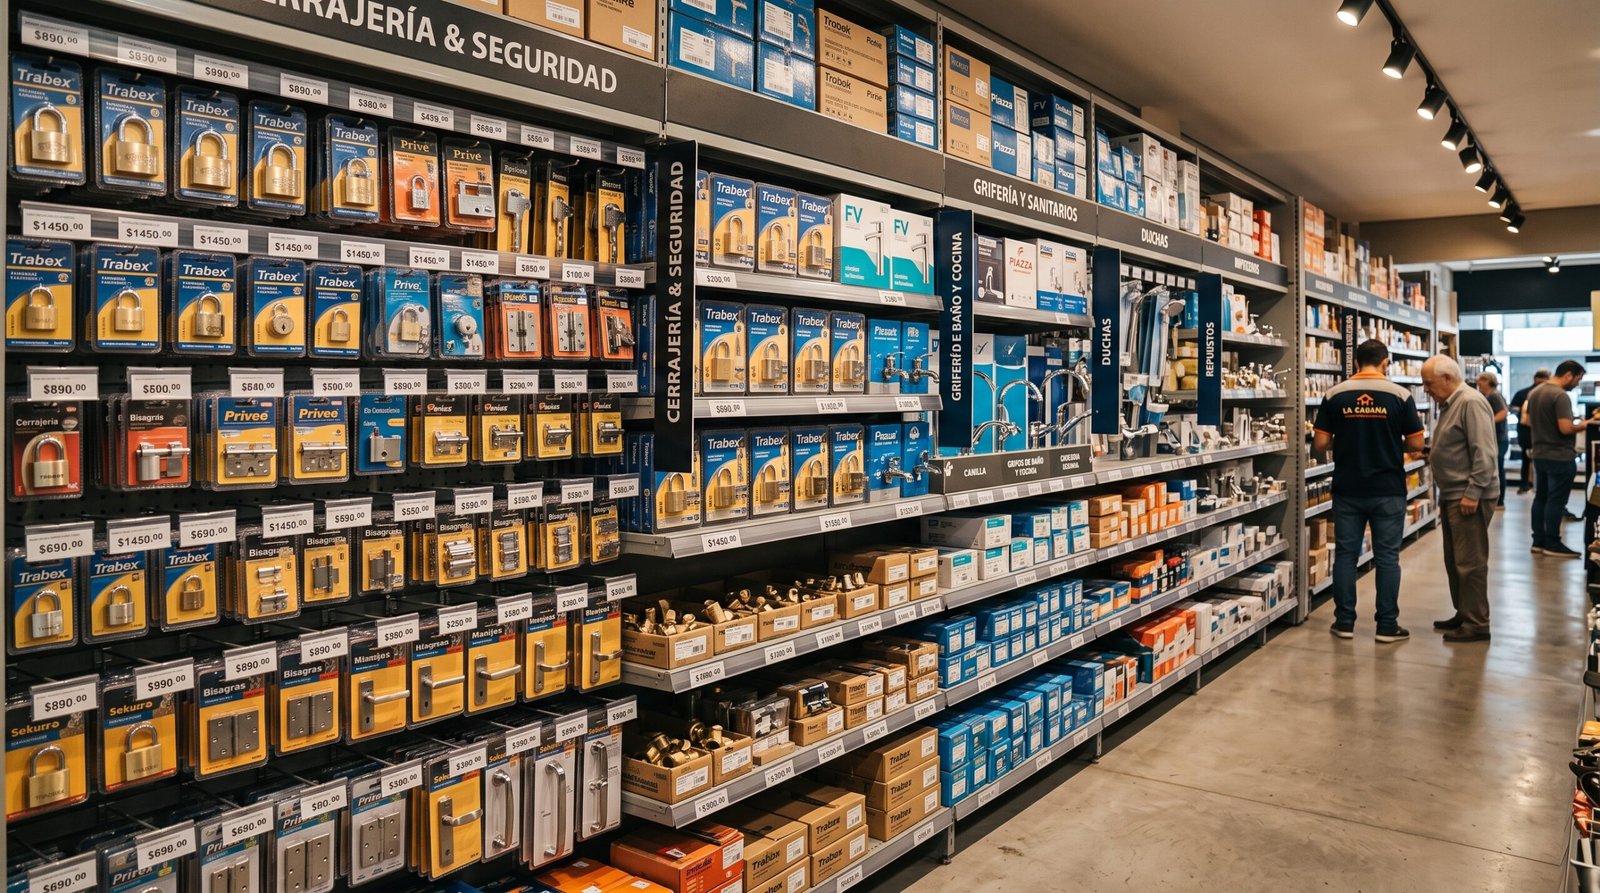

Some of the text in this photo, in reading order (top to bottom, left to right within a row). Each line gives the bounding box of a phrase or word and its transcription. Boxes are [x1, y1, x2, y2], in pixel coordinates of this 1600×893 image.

[34, 30, 78, 46] $890.00
[444, 25, 464, 54] &
[472, 32, 617, 94] SEGURIDAD
[17, 68, 72, 88] Trabex
[205, 67, 240, 80] $990.00
[107, 83, 155, 102] Trabex
[289, 84, 321, 96] $890.00
[185, 100, 229, 116] Trabex
[991, 93, 1013, 110] Piazza
[1034, 101, 1046, 110] FV
[258, 114, 298, 130] Trabex
[335, 127, 371, 142] Trabex
[716, 182, 749, 198] Trabex
[762, 191, 792, 206] Trabex
[974, 178, 1078, 222] GRIFERÍA Y SANITARIOS
[801, 200, 827, 214] Trabex
[845, 205, 863, 223] FV
[33, 220, 83, 232] $1450.00
[126, 227, 172, 239] $1450.00
[894, 219, 909, 236] FV
[200, 234, 241, 246] $1450.00
[275, 242, 312, 252] $1450.00
[10, 253, 63, 268] Trabex
[346, 249, 380, 258] $1450.00
[414, 256, 445, 265] $1450.00
[952, 232, 962, 282] COCINA
[101, 258, 149, 272] Trabex
[466, 259, 495, 267] $1450.00
[521, 264, 545, 273] $850.00
[1009, 257, 1032, 270] PIAZZA
[183, 264, 228, 278] Trabex
[258, 270, 298, 283] Trabex
[566, 270, 590, 279] $100.00
[318, 277, 355, 288] Trabex
[667, 160, 683, 424] CERRAJERÍA & SEGURIDAD
[952, 285, 962, 296] Y
[706, 308, 738, 321] Trabex
[751, 312, 781, 324] Trabex
[798, 315, 825, 327] Trabex
[951, 297, 962, 331] BAÑO
[835, 318, 860, 329] Trabex
[1102, 319, 1112, 365] DUCHAS
[43, 384, 86, 395] $890.00
[322, 381, 353, 390] $500.00
[224, 410, 268, 422] Privee
[299, 409, 338, 419] Privee
[708, 436, 740, 450] Trabex
[755, 435, 784, 447] Trabex
[796, 434, 823, 445] Trabex
[835, 432, 859, 444] Trabex
[964, 467, 987, 477] CANILLA
[402, 505, 429, 515] $550.00
[461, 499, 487, 510] $590.00
[269, 519, 307, 531] $1450.00
[117, 533, 163, 547] $1450.00
[191, 526, 228, 540] $690.00
[39, 540, 83, 554] $690.00
[708, 535, 737, 547] $1450.00
[169, 552, 209, 565] Trabex
[94, 560, 139, 574] Trabex
[19, 569, 66, 583] Trabex
[309, 642, 343, 657] $890.00
[236, 658, 270, 673] $890.00
[283, 665, 322, 678] Bisagras
[147, 675, 185, 691] $990.00
[204, 682, 246, 697] Bisagras
[45, 694, 87, 712] $890.00
[109, 701, 153, 717] Sekurro
[11, 721, 60, 738] Sekurro
[43, 872, 87, 893] $690.00
